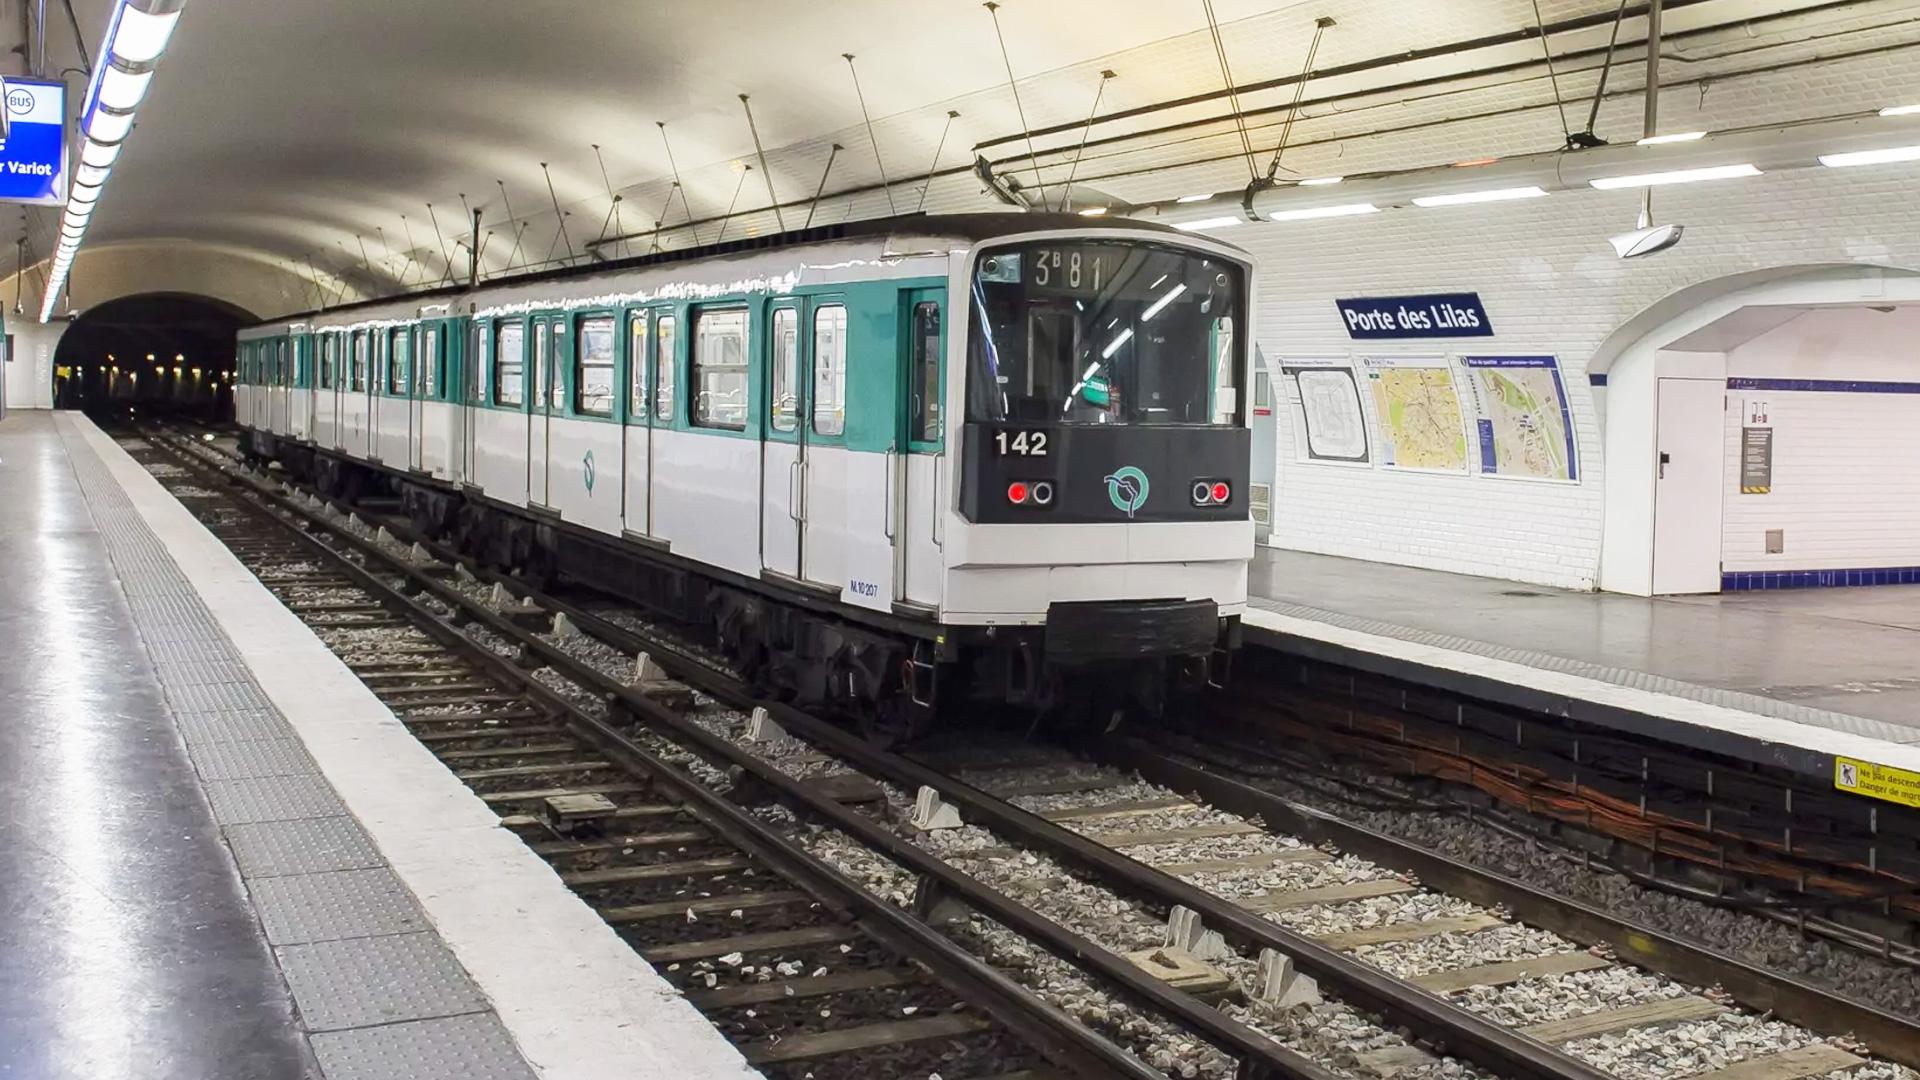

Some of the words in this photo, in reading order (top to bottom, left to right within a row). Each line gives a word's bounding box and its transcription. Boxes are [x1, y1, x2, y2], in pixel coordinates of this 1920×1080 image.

[9, 96, 32, 107] BUS
[8, 161, 52, 176] Variot
[1344, 308, 1396, 331] Porte
[1397, 305, 1431, 330] des
[1430, 303, 1480, 328] Lilas
[995, 431, 1047, 455] 142
[1860, 768, 1871, 778] Ne
[1860, 781, 1888, 794] Danger
[1889, 787, 1899, 796] de
